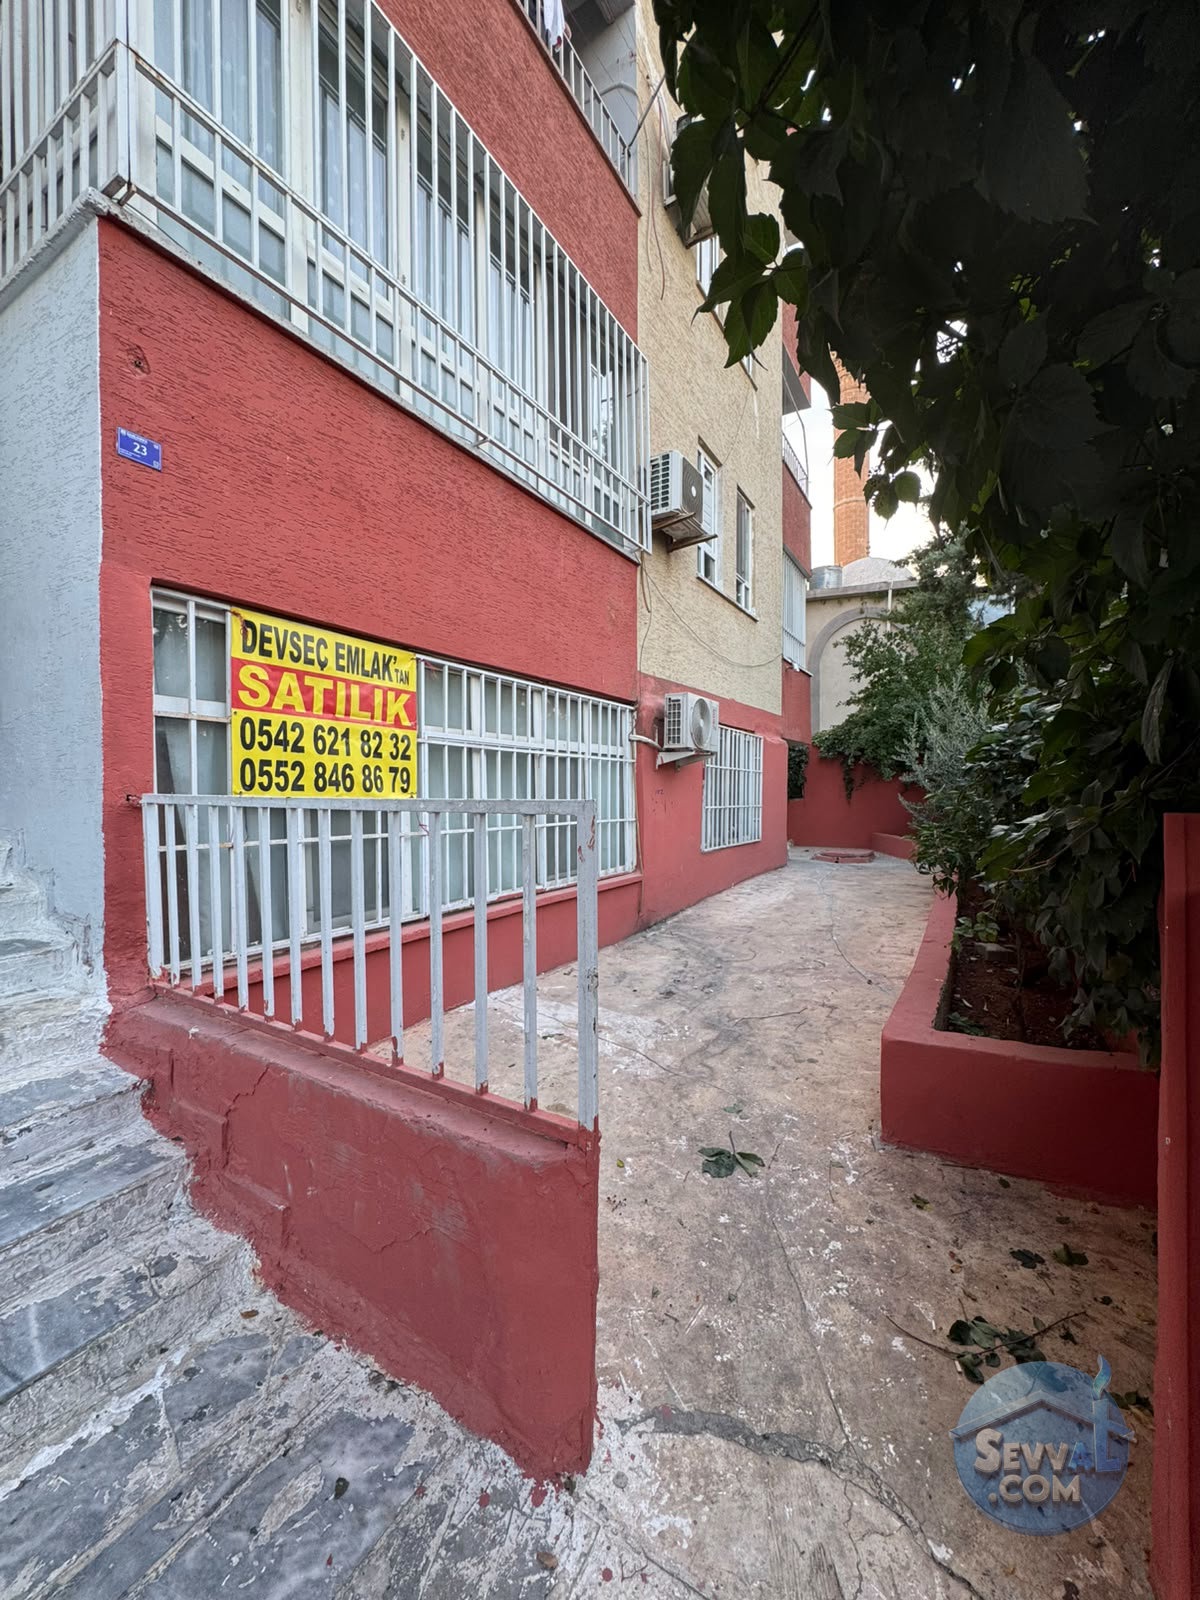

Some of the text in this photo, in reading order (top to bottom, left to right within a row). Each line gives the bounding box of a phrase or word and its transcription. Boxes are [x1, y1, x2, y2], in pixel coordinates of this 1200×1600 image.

[133, 441, 147, 456] 23
[241, 619, 328, 671] DEVSEÇ
[238, 664, 412, 727] SATILIK
[240, 717, 411, 762] 0542 621 82 32
[240, 758, 411, 794] 0552 846 86 79
